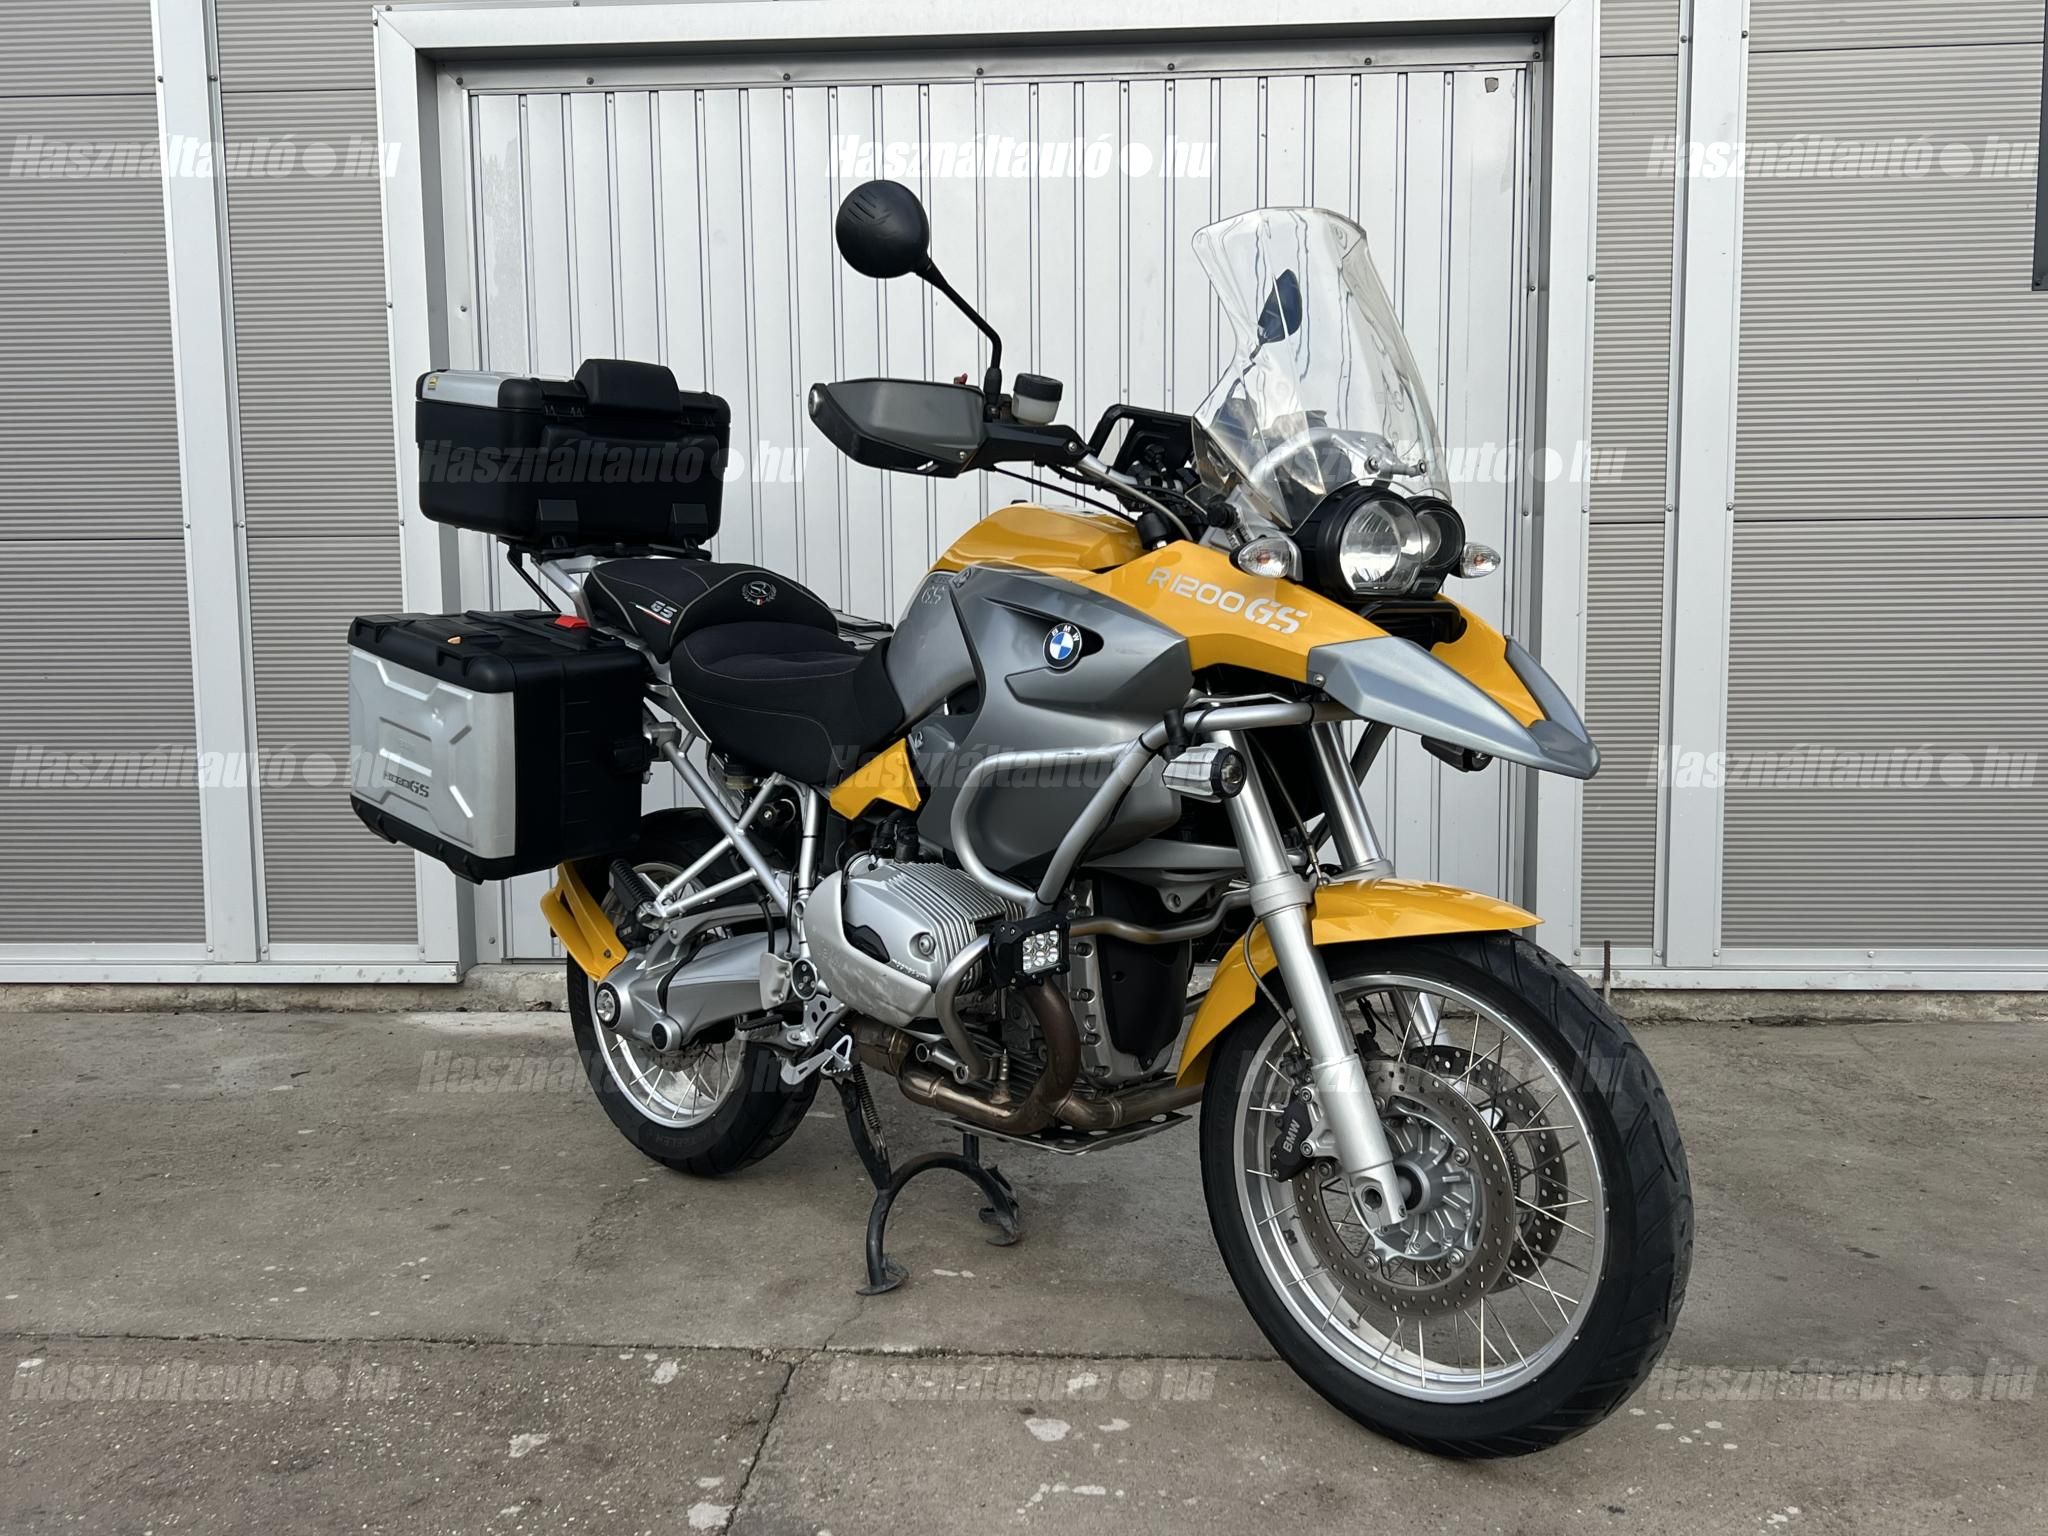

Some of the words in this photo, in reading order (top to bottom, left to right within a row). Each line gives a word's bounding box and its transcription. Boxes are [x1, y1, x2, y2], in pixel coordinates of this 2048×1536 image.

[650, 600, 678, 619] GS
[1147, 567, 1308, 635] R1200GS
[1051, 624, 1080, 642] BMW
[1282, 1119, 1300, 1153] BMW
